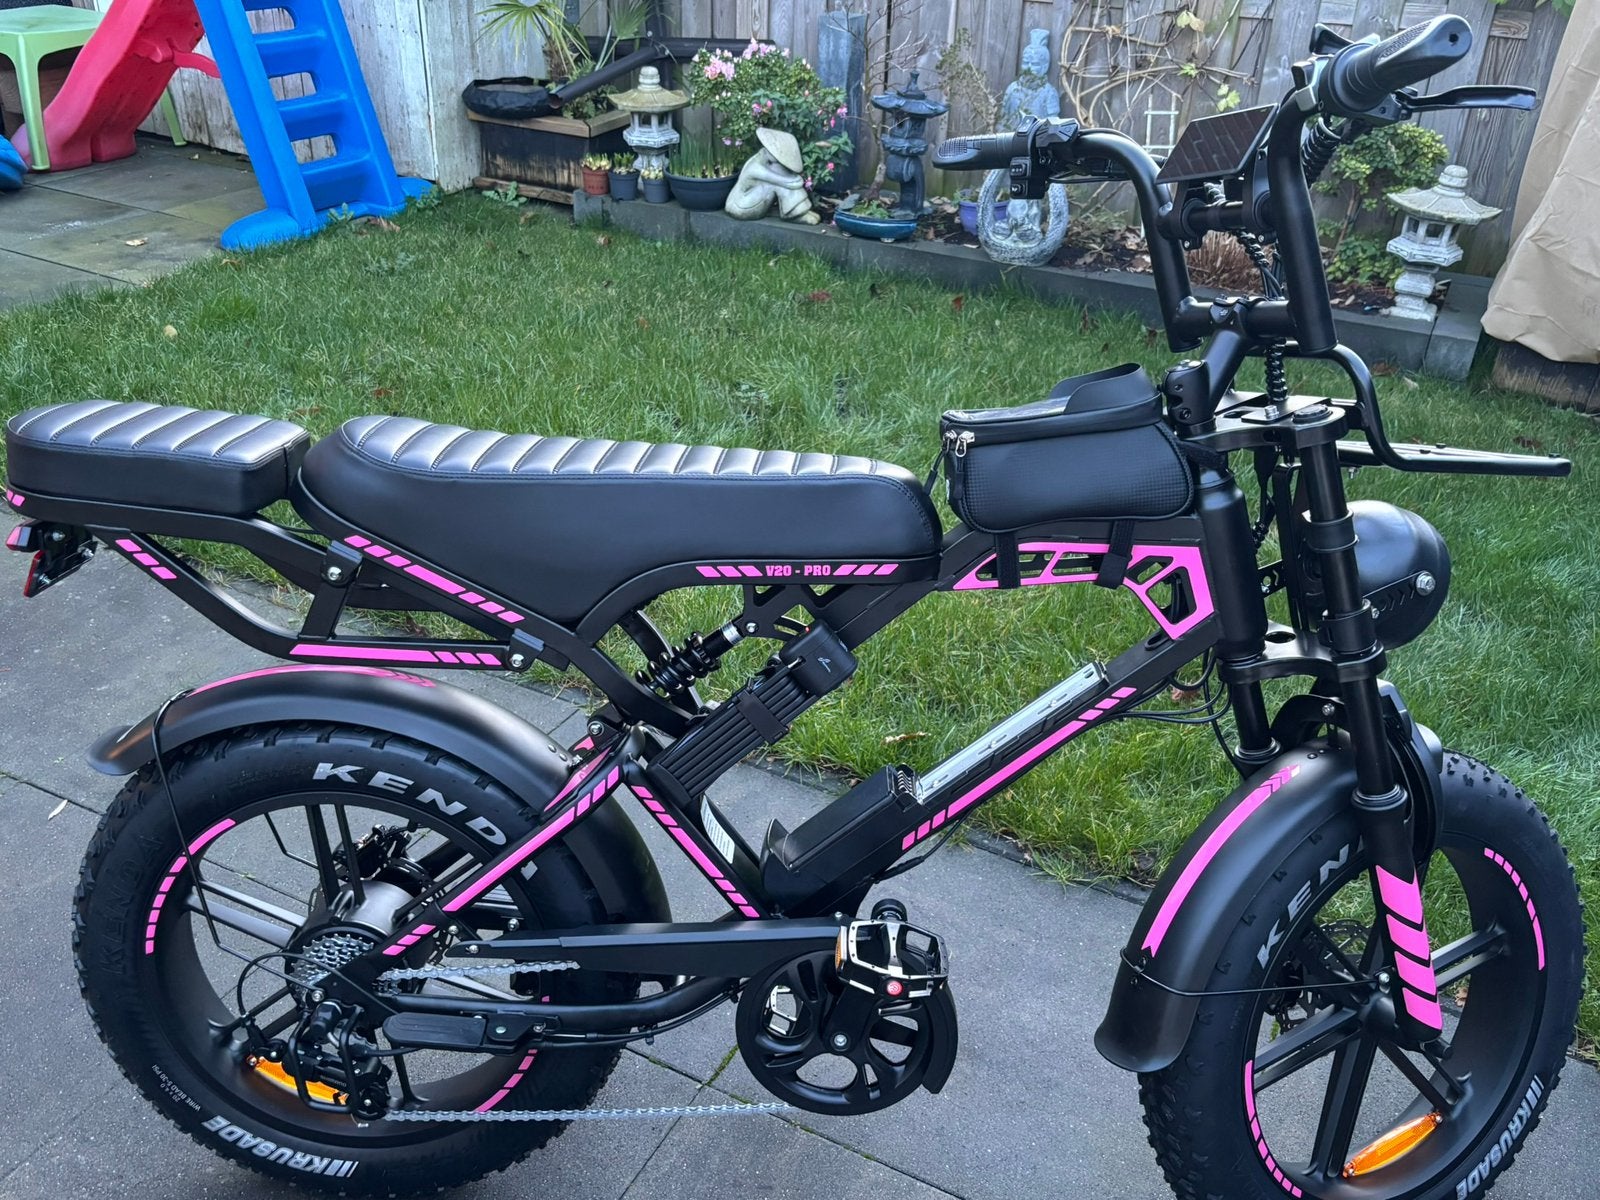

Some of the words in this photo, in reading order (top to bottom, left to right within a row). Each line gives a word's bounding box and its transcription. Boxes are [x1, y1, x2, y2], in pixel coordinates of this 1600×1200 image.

[765, 565, 792, 577] V20
[804, 564, 832, 577] PRO
[312, 762, 538, 881] KEND
[1256, 834, 1364, 970] KEN
[171, 1084, 187, 1100] BEAD
[185, 1097, 201, 1111] WIRE
[202, 1115, 332, 1173] KRUSADE
[1455, 1098, 1532, 1200] KRUSADE
